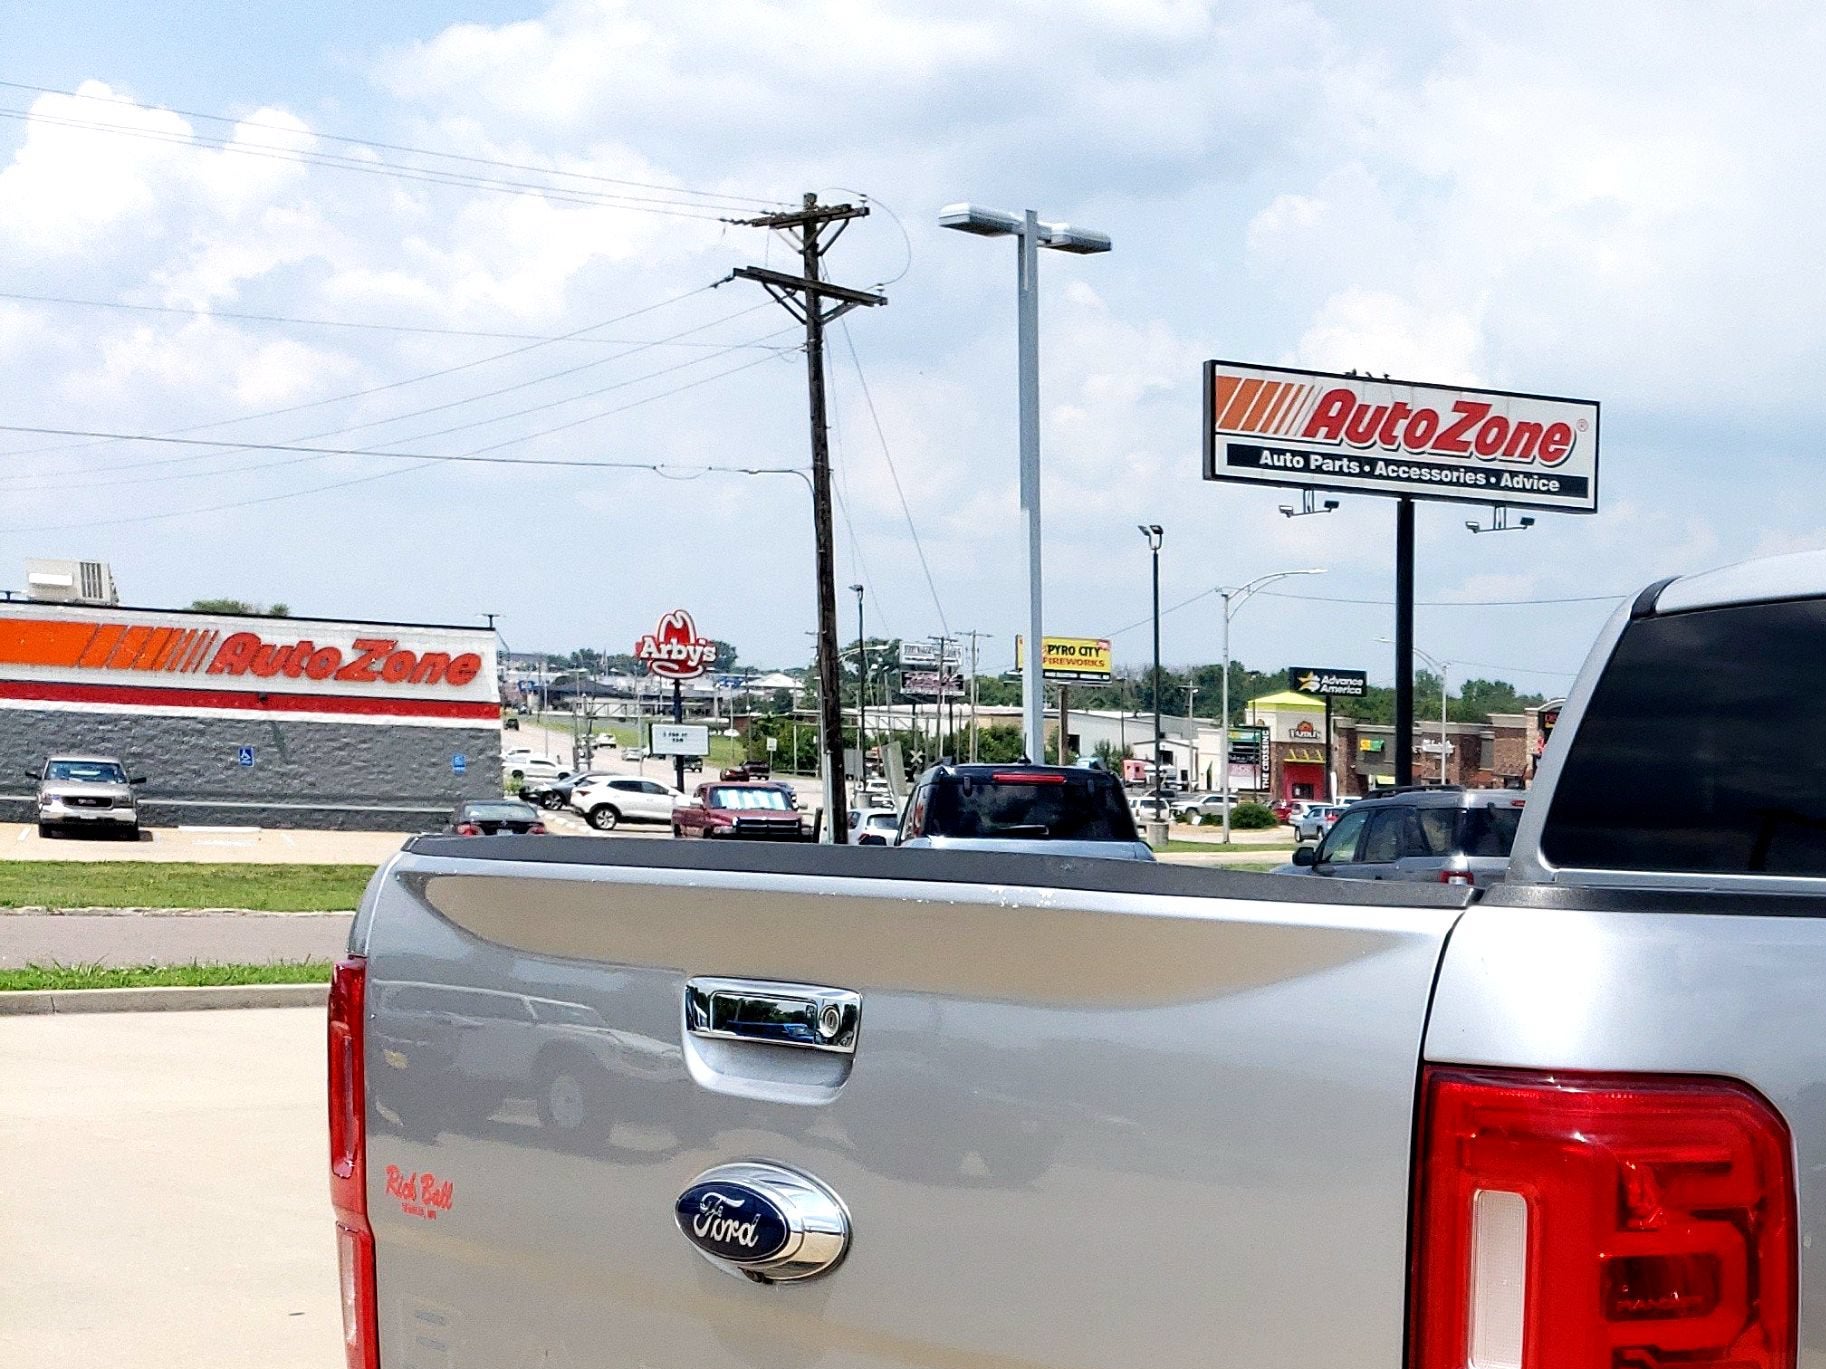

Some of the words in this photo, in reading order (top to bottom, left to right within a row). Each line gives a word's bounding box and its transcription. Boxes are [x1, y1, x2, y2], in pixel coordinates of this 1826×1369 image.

[1301, 388, 1577, 468] AutoZone
[1259, 449, 1305, 469] Auto
[1309, 453, 1361, 475] Parts
[1374, 460, 1487, 487] Accessories
[1500, 471, 1561, 493] Advice
[207, 632, 483, 687] AutoZone
[640, 636, 717, 667] Arby's
[1043, 656, 1105, 668] FIREWORKS
[1047, 644, 1076, 656] PYRO
[1078, 646, 1101, 657] CITY
[1320, 685, 1363, 695] America
[1321, 675, 1364, 687] Advance
[1262, 729, 1270, 772] CROSSING
[1262, 772, 1270, 790] THE
[694, 1192, 761, 1249] Ford
